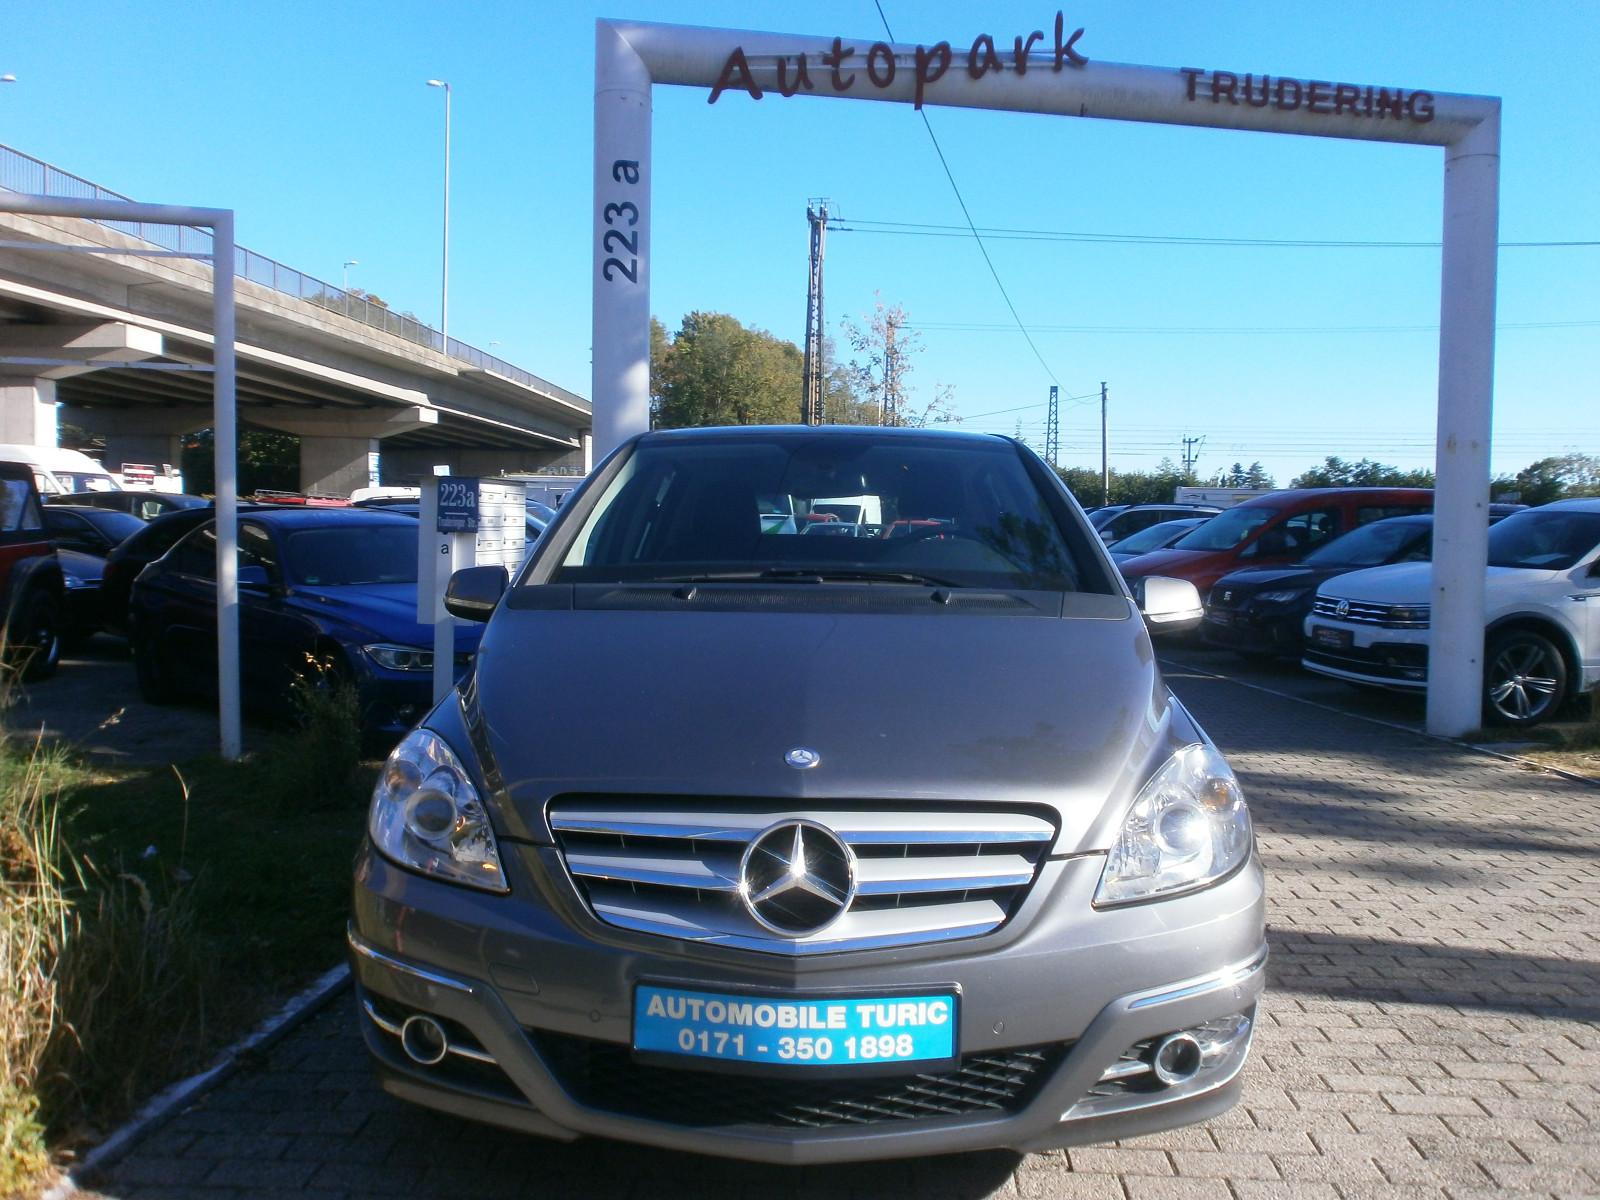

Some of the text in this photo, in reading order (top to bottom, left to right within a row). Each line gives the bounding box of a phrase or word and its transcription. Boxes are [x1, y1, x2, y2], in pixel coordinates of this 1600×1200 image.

[707, 10, 1089, 111] Autopark
[1181, 66, 1435, 123] TRUDERING
[603, 160, 640, 284] 223 a
[440, 483, 475, 508] 223a
[646, 994, 948, 1029] AUTOMOBILE TURIC
[678, 1028, 745, 1056] 0171
[777, 1036, 833, 1060] 350
[844, 1033, 914, 1060] 1898
